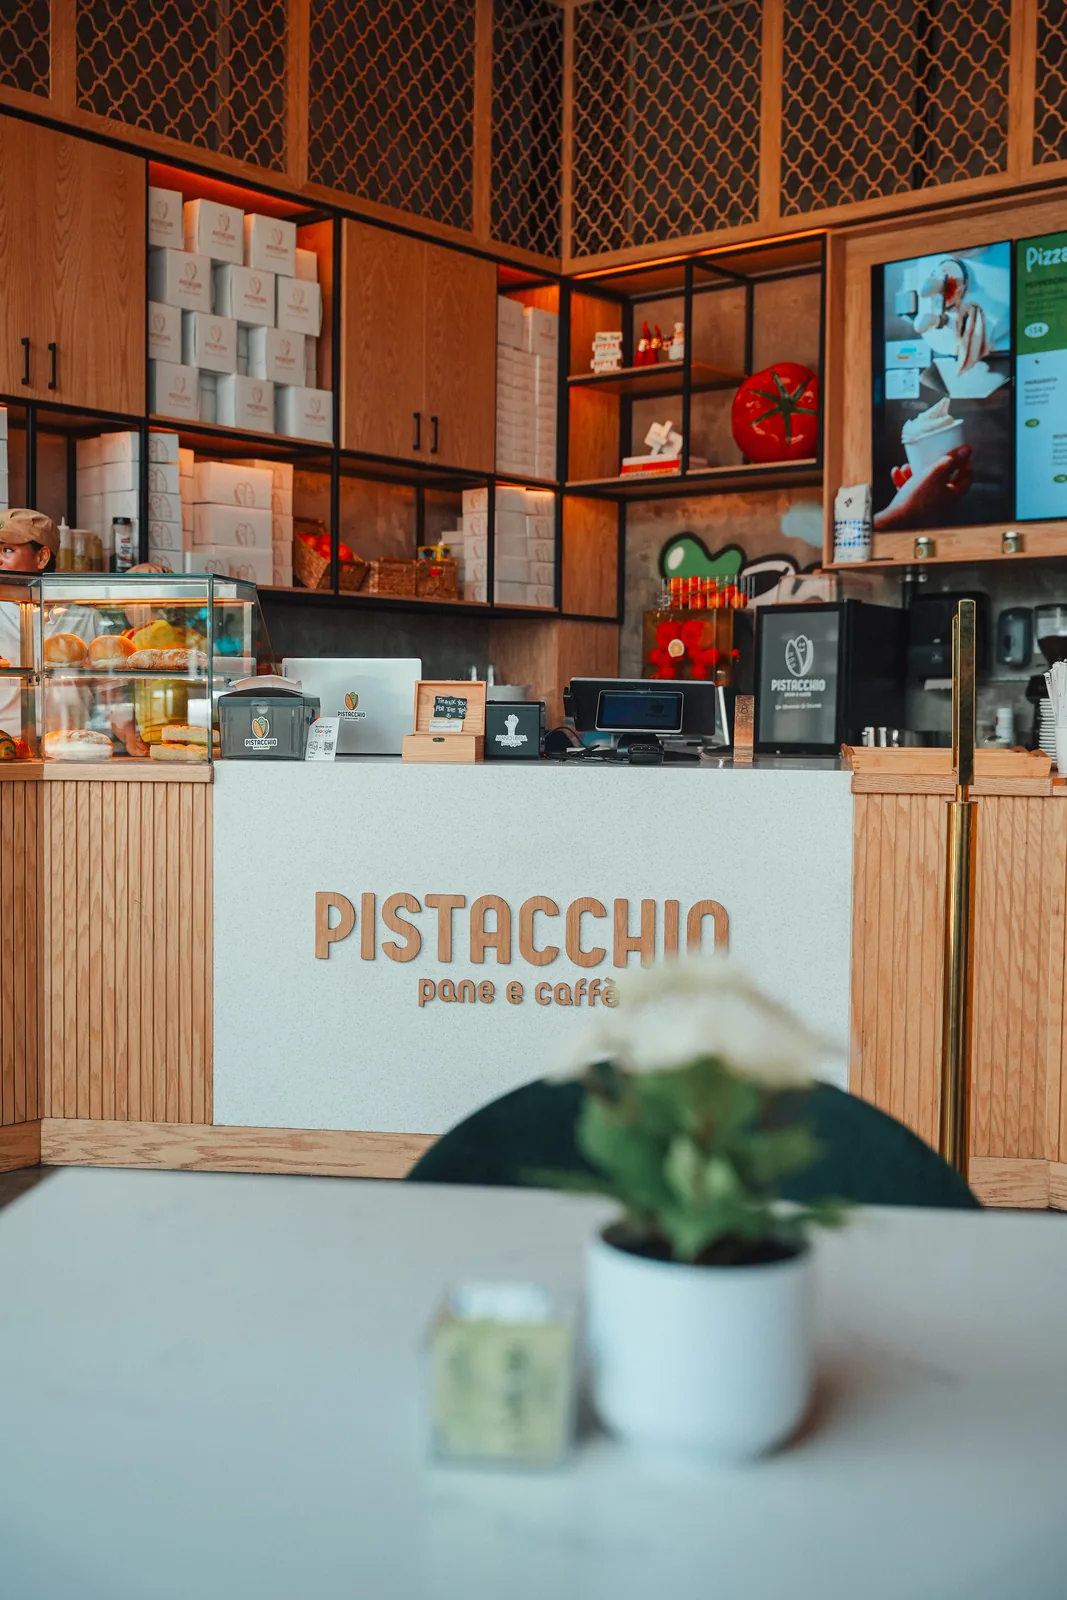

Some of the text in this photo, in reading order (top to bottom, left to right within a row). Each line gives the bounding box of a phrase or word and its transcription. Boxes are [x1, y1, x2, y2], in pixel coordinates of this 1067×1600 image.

[771, 679, 826, 692] PISTACCHIO
[245, 738, 277, 746] PISTACCHIO
[315, 891, 730, 968] PISTACCHIO
[418, 977, 621, 1007] pane e caffè
